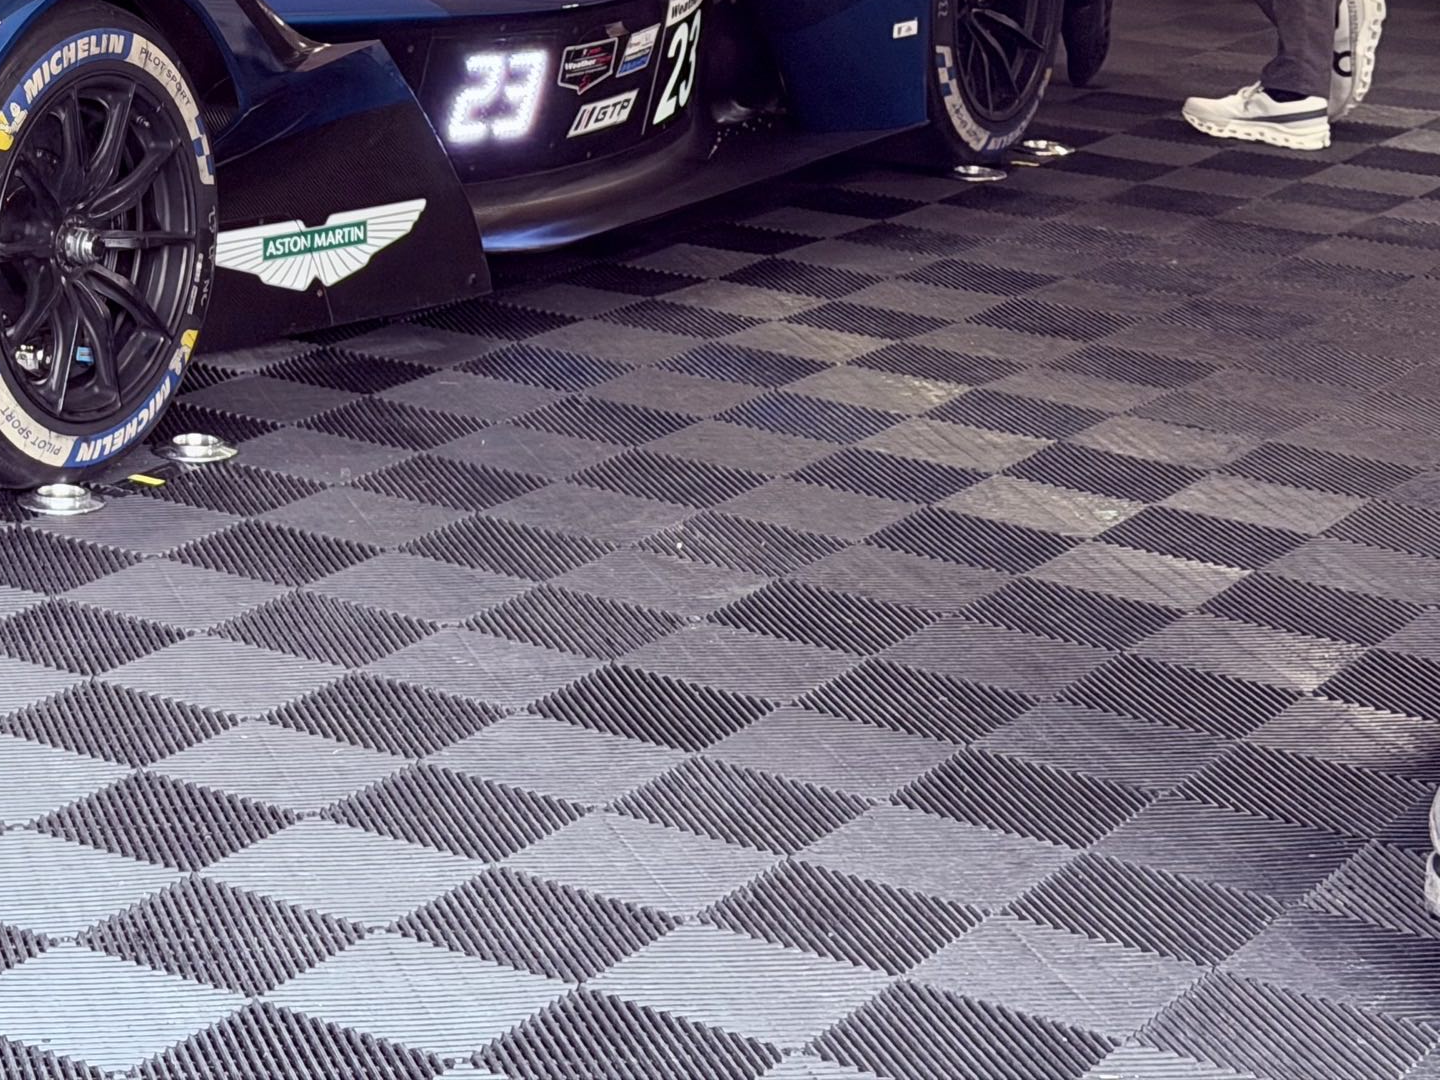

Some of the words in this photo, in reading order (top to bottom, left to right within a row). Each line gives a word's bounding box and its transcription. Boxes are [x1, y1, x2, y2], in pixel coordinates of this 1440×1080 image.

[23, 33, 125, 105] MICHELIN
[139, 47, 167, 72] PILOT
[166, 67, 192, 106] SPORT
[653, 9, 701, 125] 23
[448, 49, 548, 143] 23
[594, 98, 631, 123] GTP
[266, 235, 311, 256] ASTON
[313, 225, 364, 248] MARTIN
[0, 407, 32, 443] SPORT
[30, 433, 62, 456] PILOT
[75, 376, 172, 463] MICHELIN
